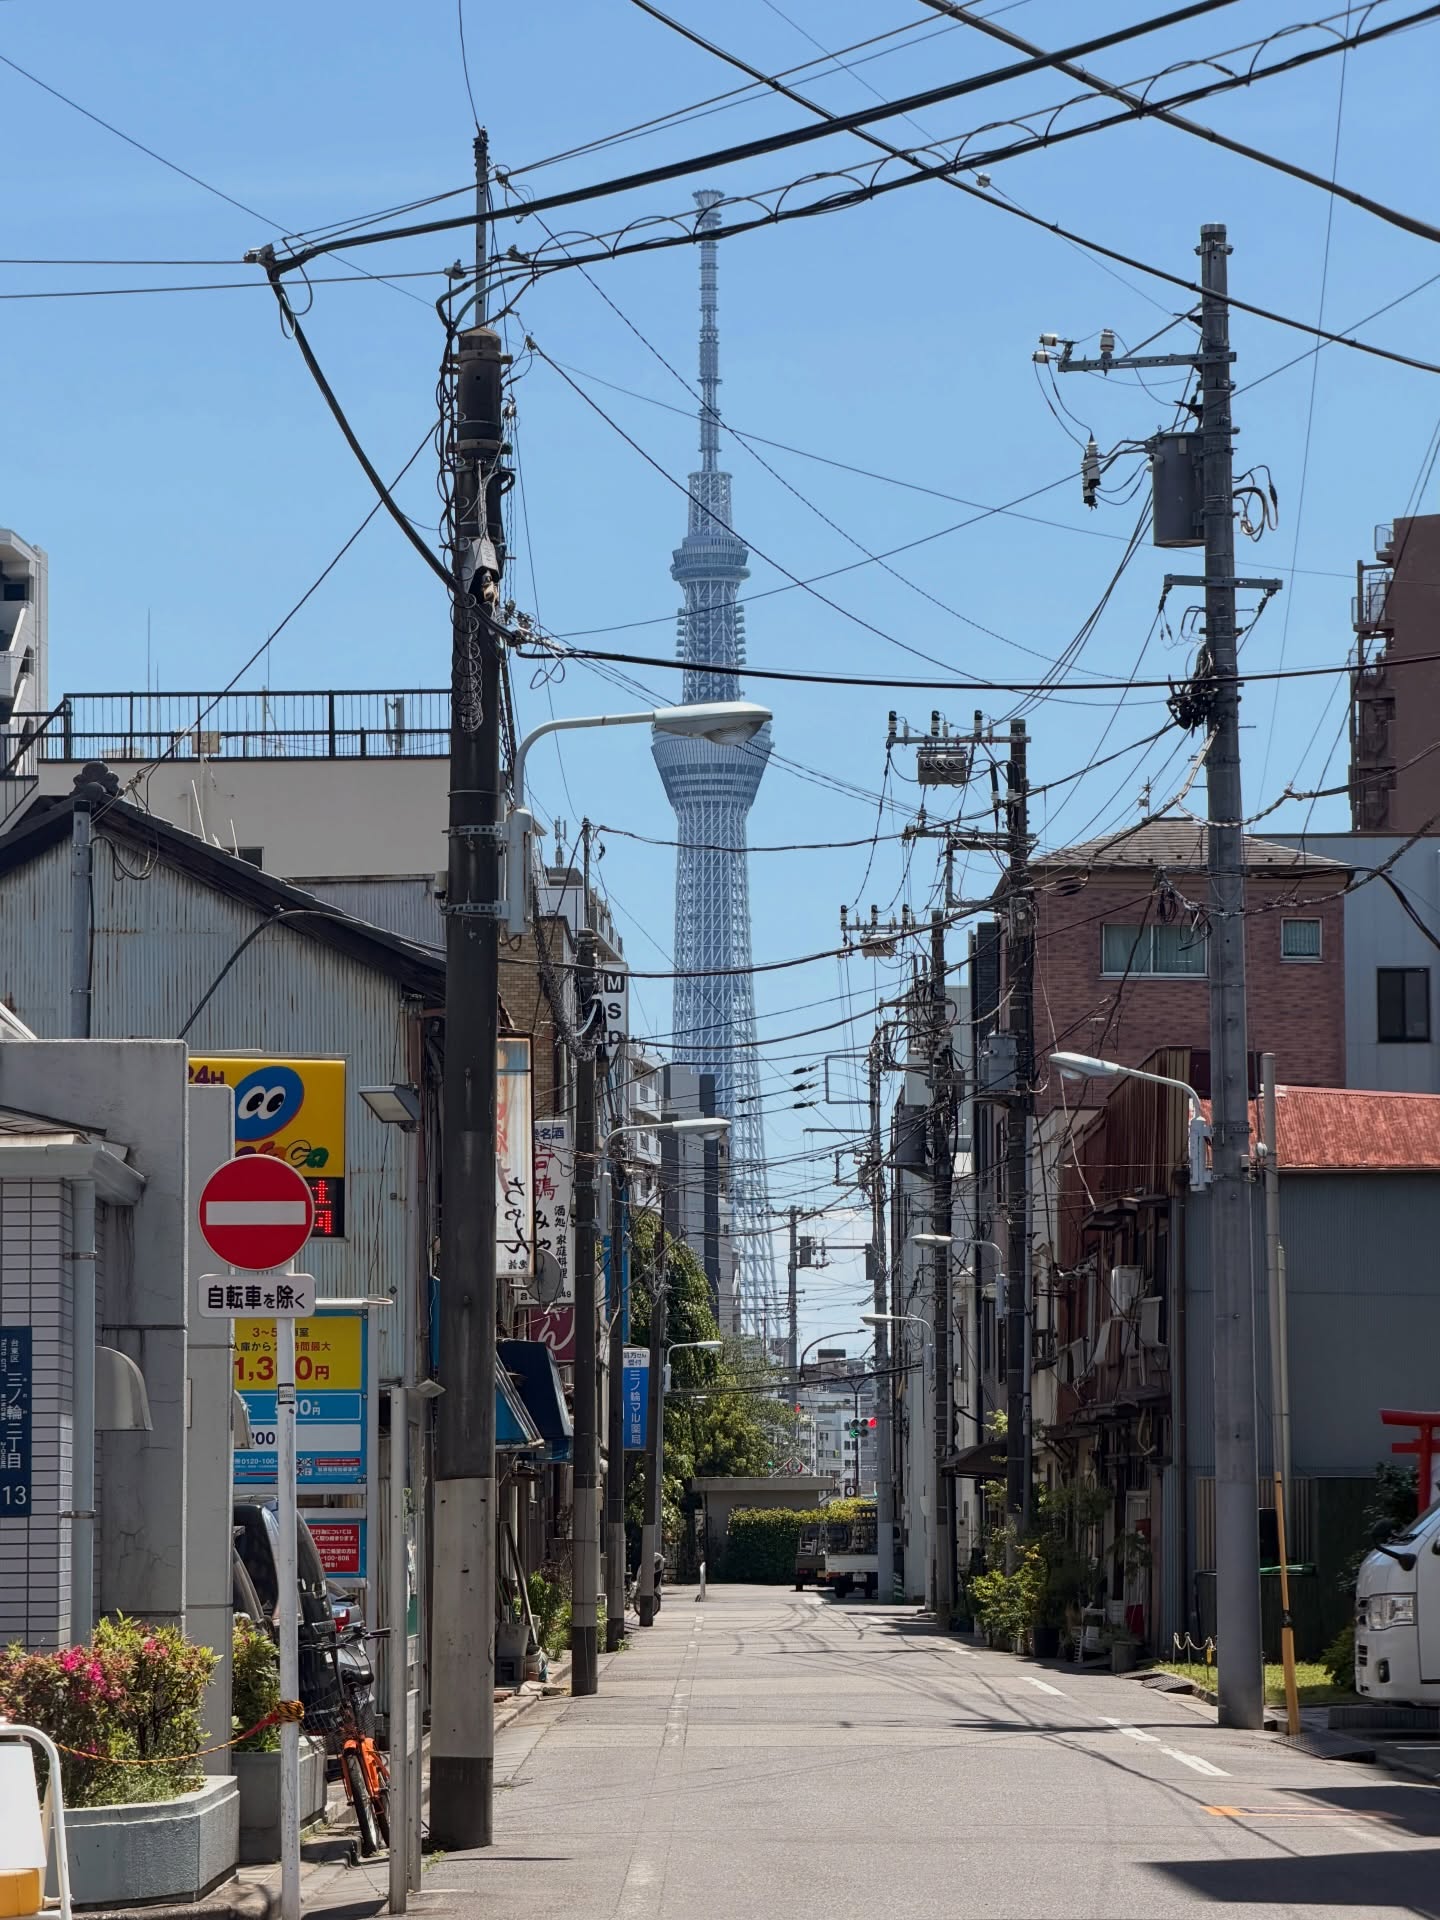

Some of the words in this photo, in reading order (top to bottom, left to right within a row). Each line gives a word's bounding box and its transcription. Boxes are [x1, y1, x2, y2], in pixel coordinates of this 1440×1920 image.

[207, 1284, 306, 1310] 自転車を除く
[6, 1372, 23, 1469] 三ノ輪二丁目
[2, 1485, 27, 1505] 13
